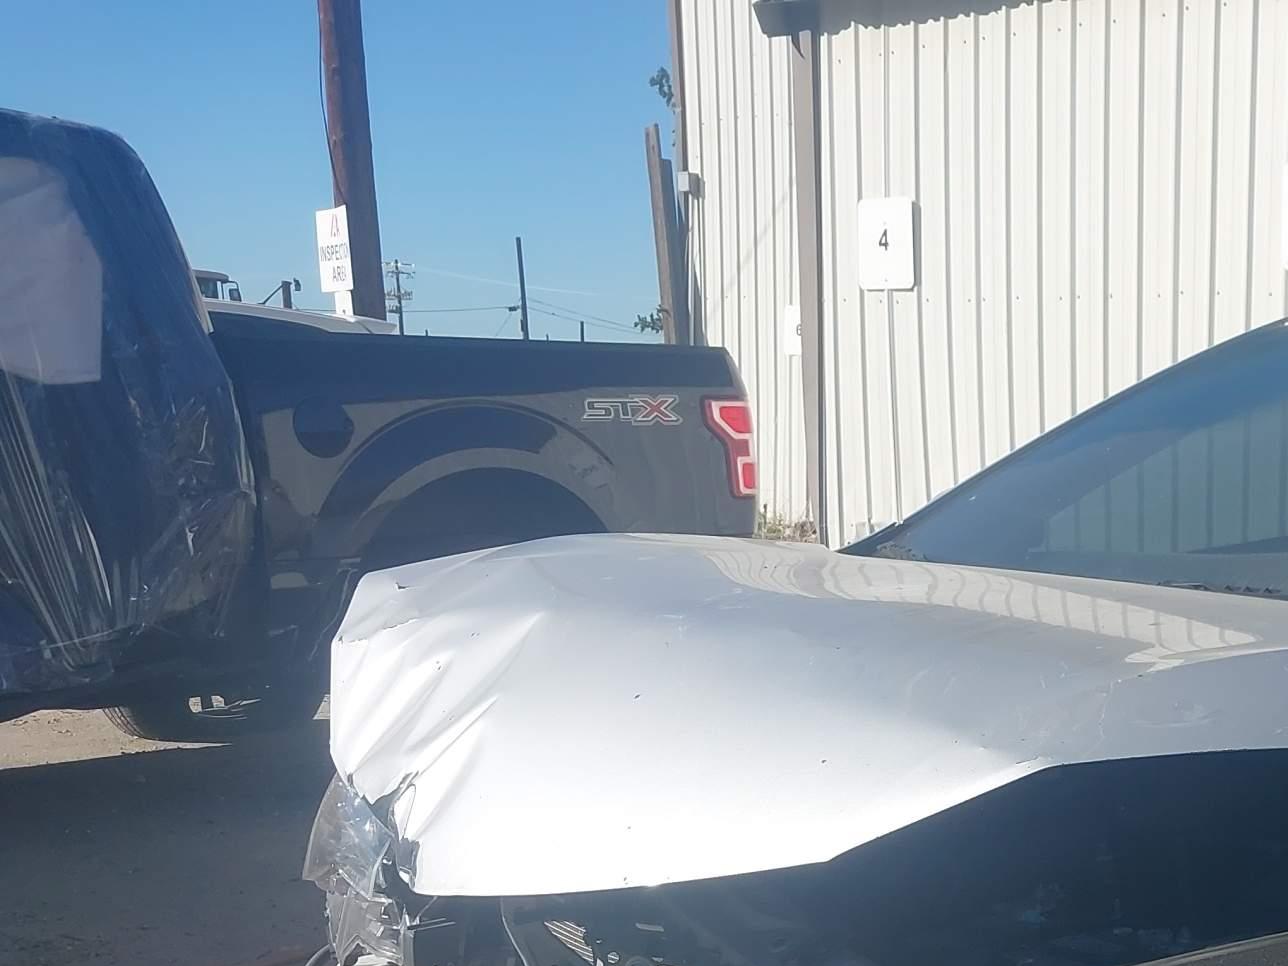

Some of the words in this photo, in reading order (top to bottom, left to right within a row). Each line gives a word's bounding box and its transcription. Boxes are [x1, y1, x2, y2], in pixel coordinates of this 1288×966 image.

[878, 229, 890, 251] 4
[320, 242, 349, 262] INSPECTIO
[582, 394, 683, 425] STX
